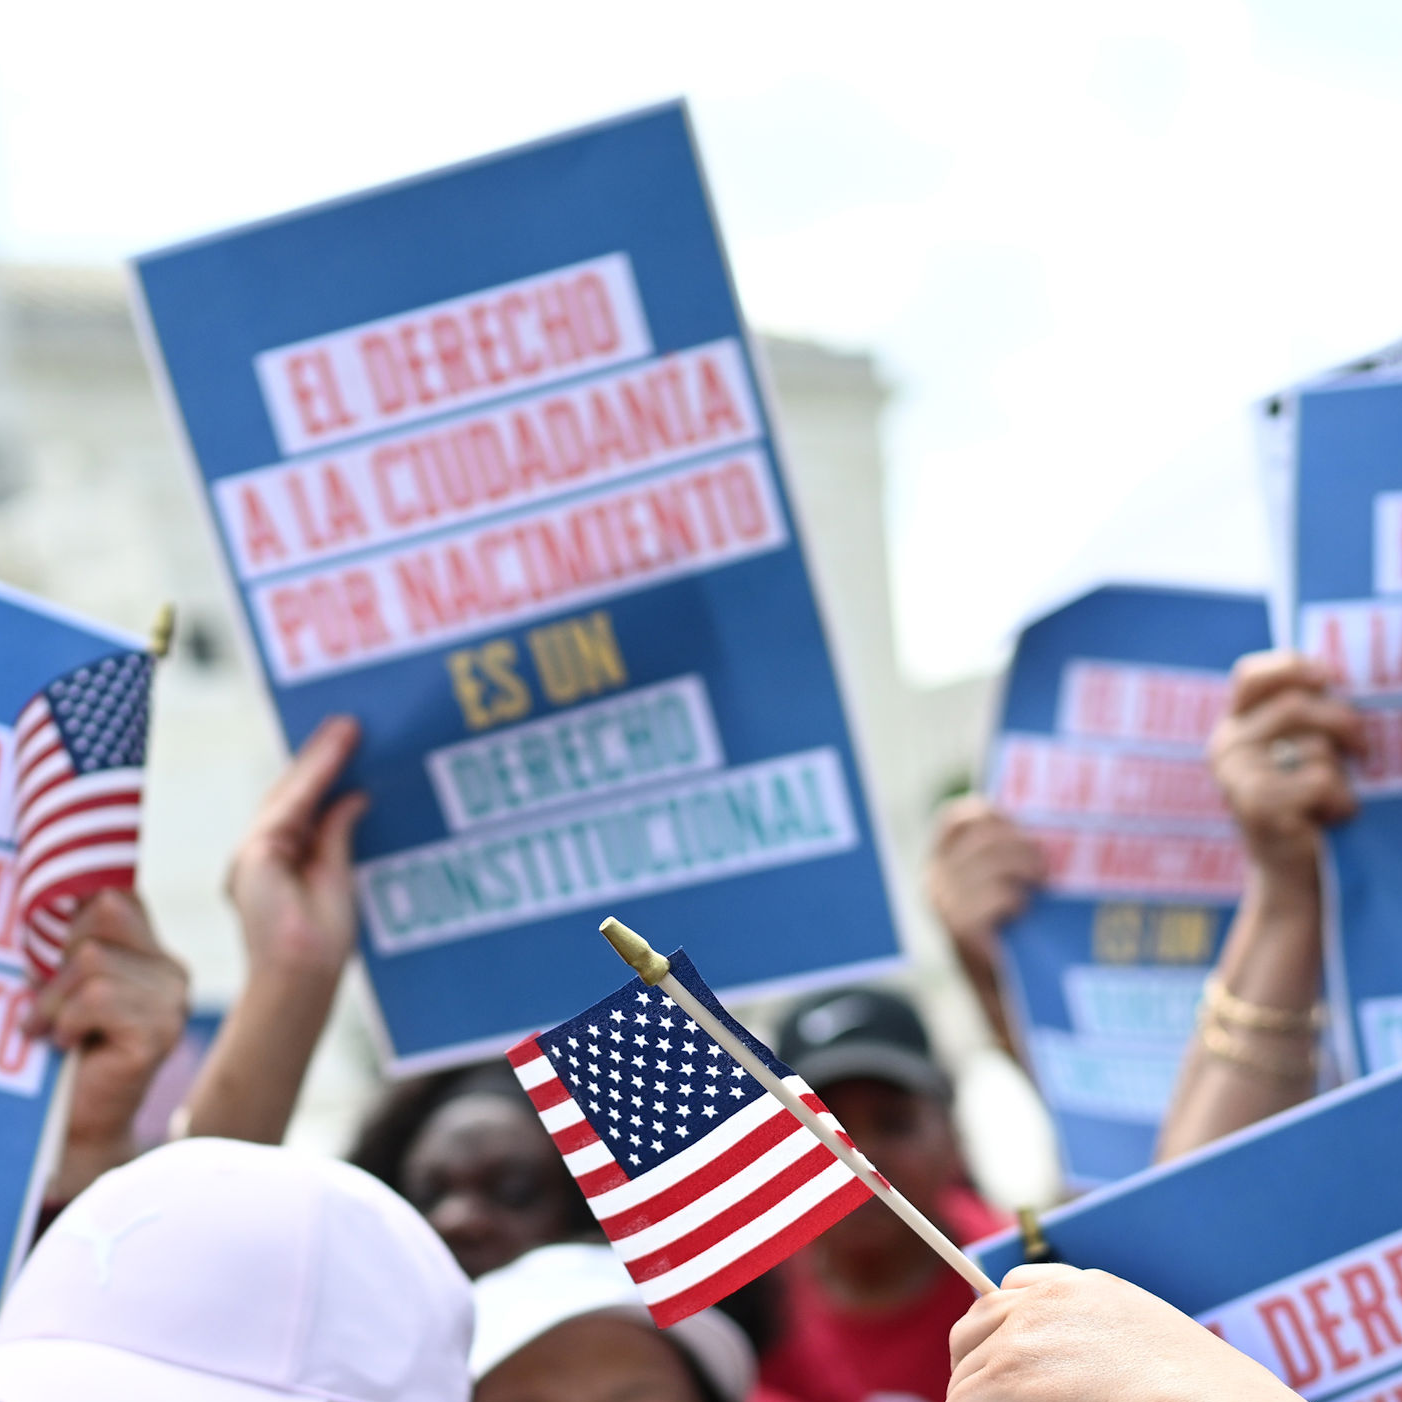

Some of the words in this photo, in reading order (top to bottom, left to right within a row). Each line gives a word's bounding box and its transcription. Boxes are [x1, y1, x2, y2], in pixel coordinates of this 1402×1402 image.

[286, 349, 357, 435] EL
[360, 272, 622, 416] DERECHO
[241, 486, 286, 564] A
[285, 462, 368, 549] LA
[372, 351, 743, 529] CIUDADANÍA
[270, 572, 391, 669] POR
[395, 460, 767, 633] NACIMIENTO
[447, 638, 532, 730] ES
[530, 612, 628, 704] UN
[1318, 614, 1350, 688] A
[448, 691, 701, 816] DERECHO
[370, 768, 836, 934] CONSTITUCIONAL
